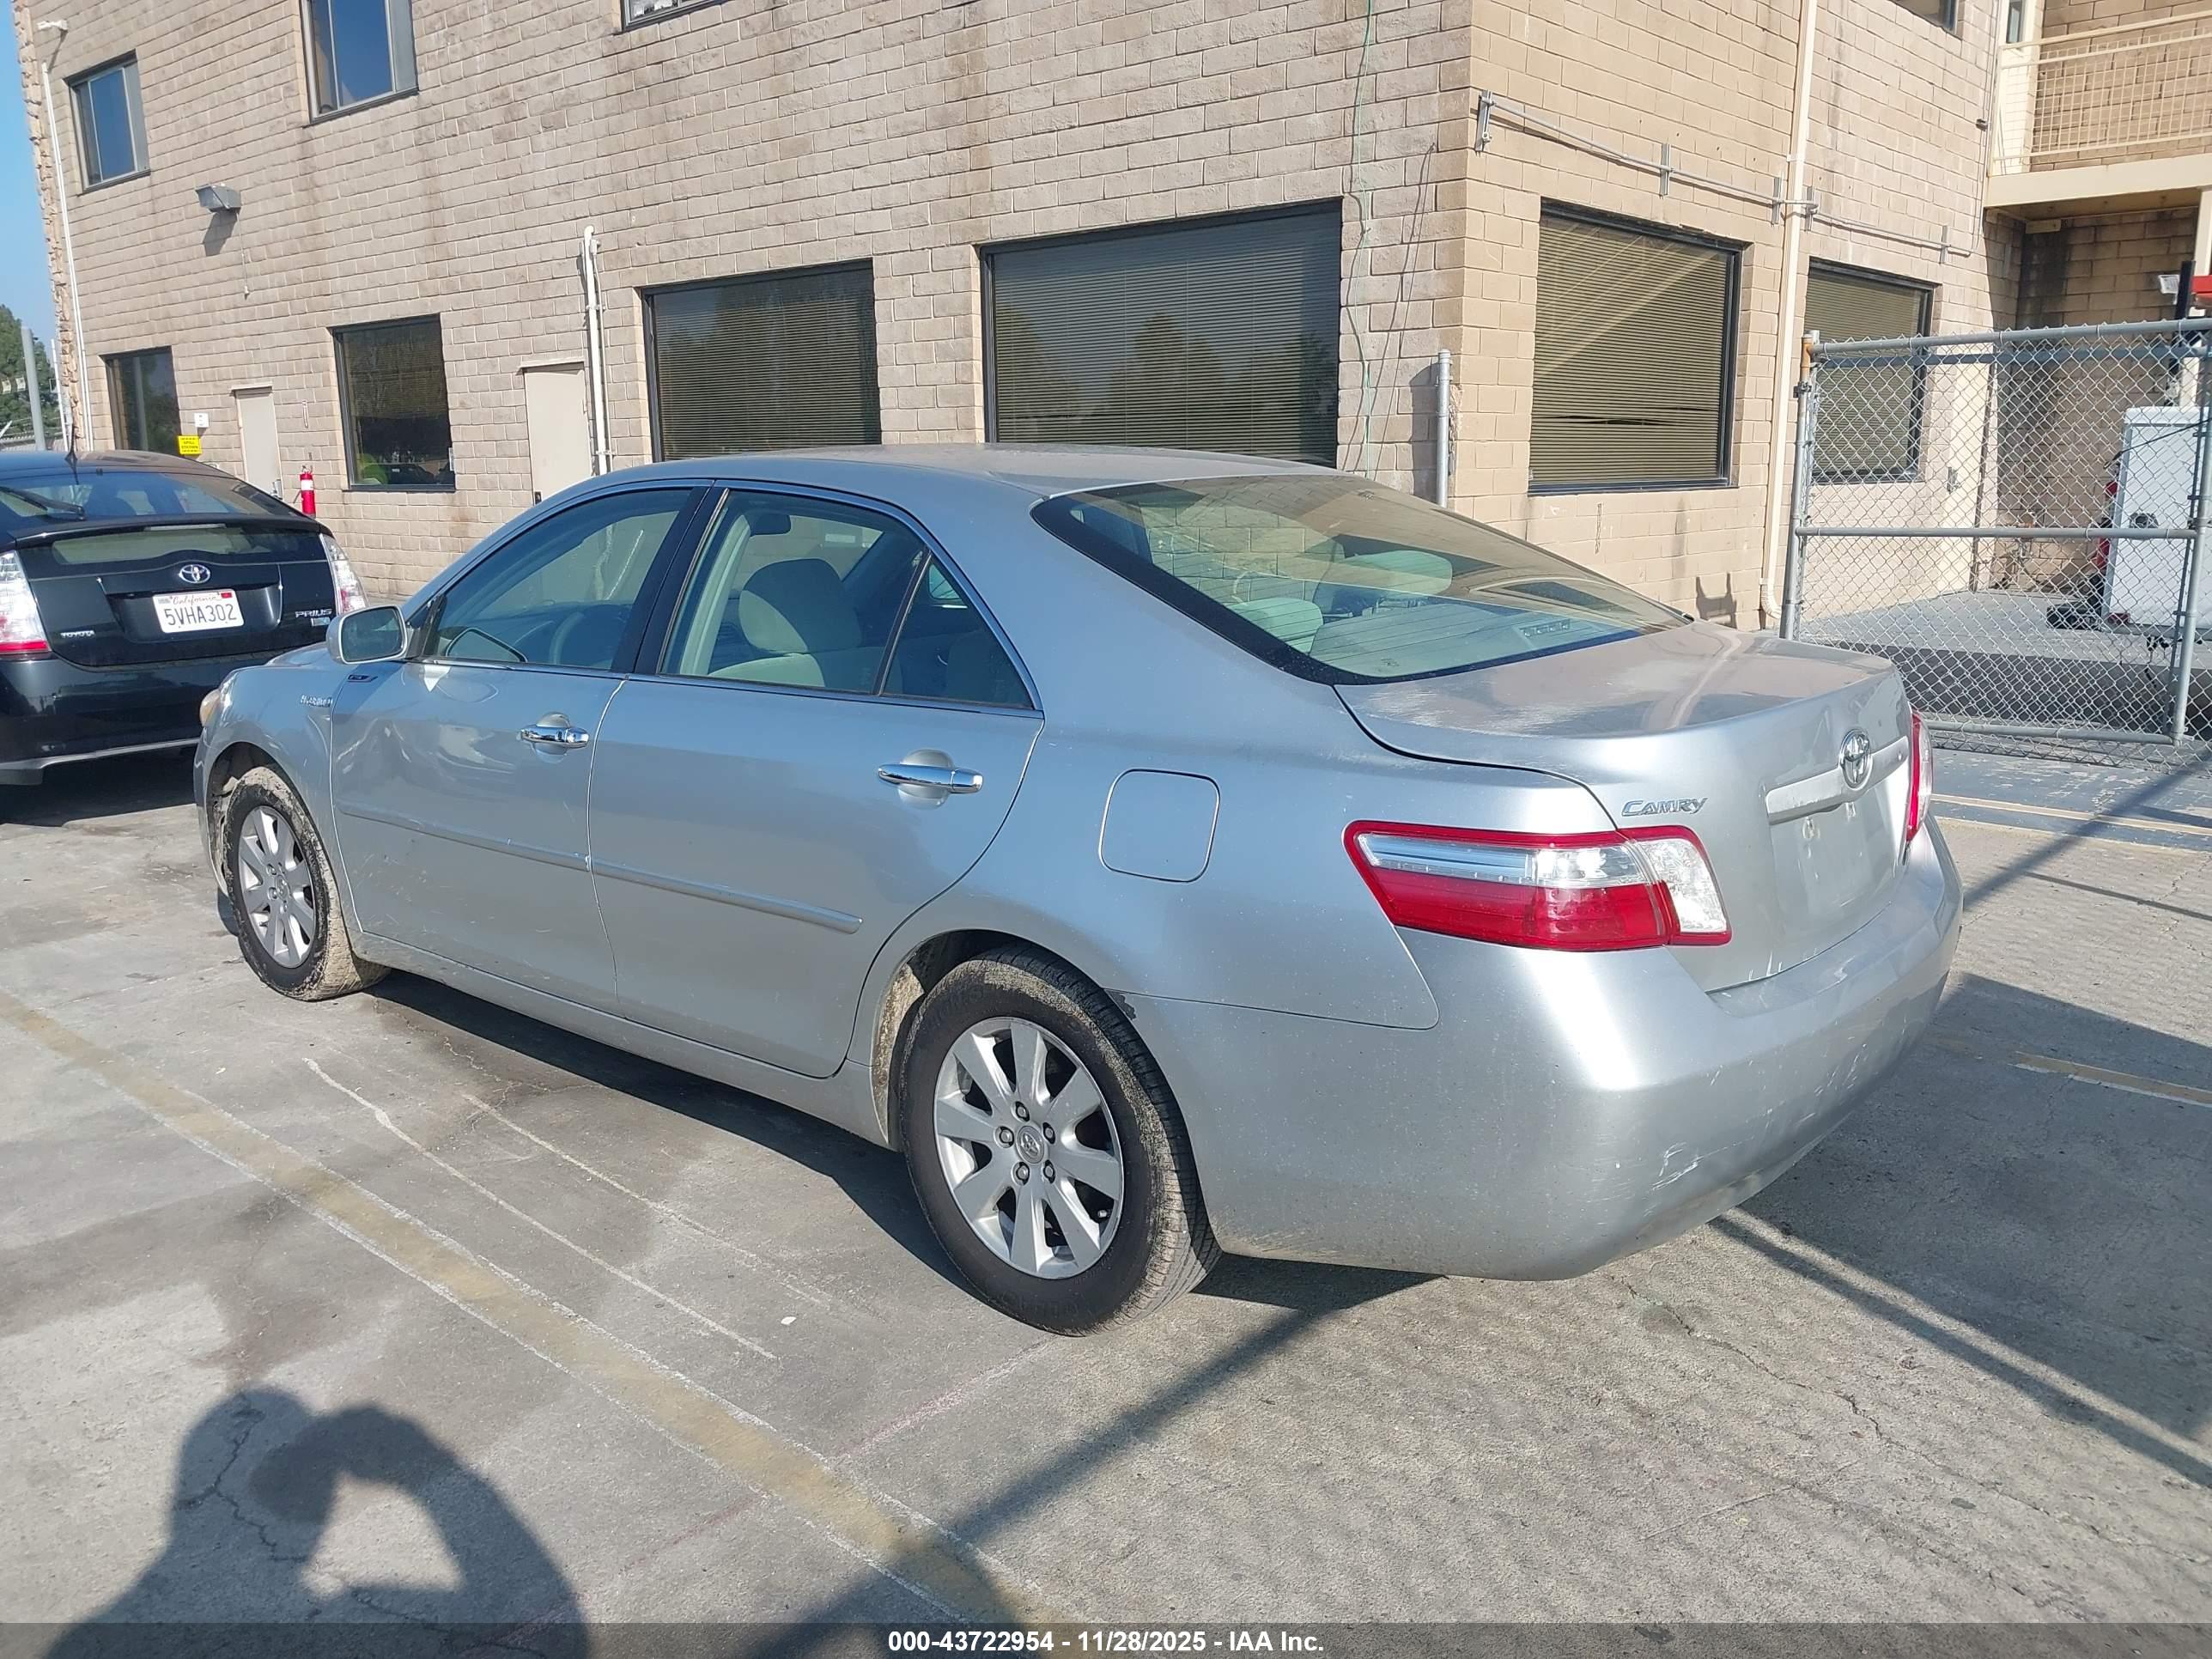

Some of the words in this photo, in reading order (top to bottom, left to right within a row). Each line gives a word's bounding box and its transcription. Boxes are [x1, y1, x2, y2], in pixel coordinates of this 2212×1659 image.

[173, 594, 220, 606] California
[164, 603, 237, 626] 5VHA302
[295, 608, 333, 618] PRIUS
[60, 629, 95, 638] TOYOTA
